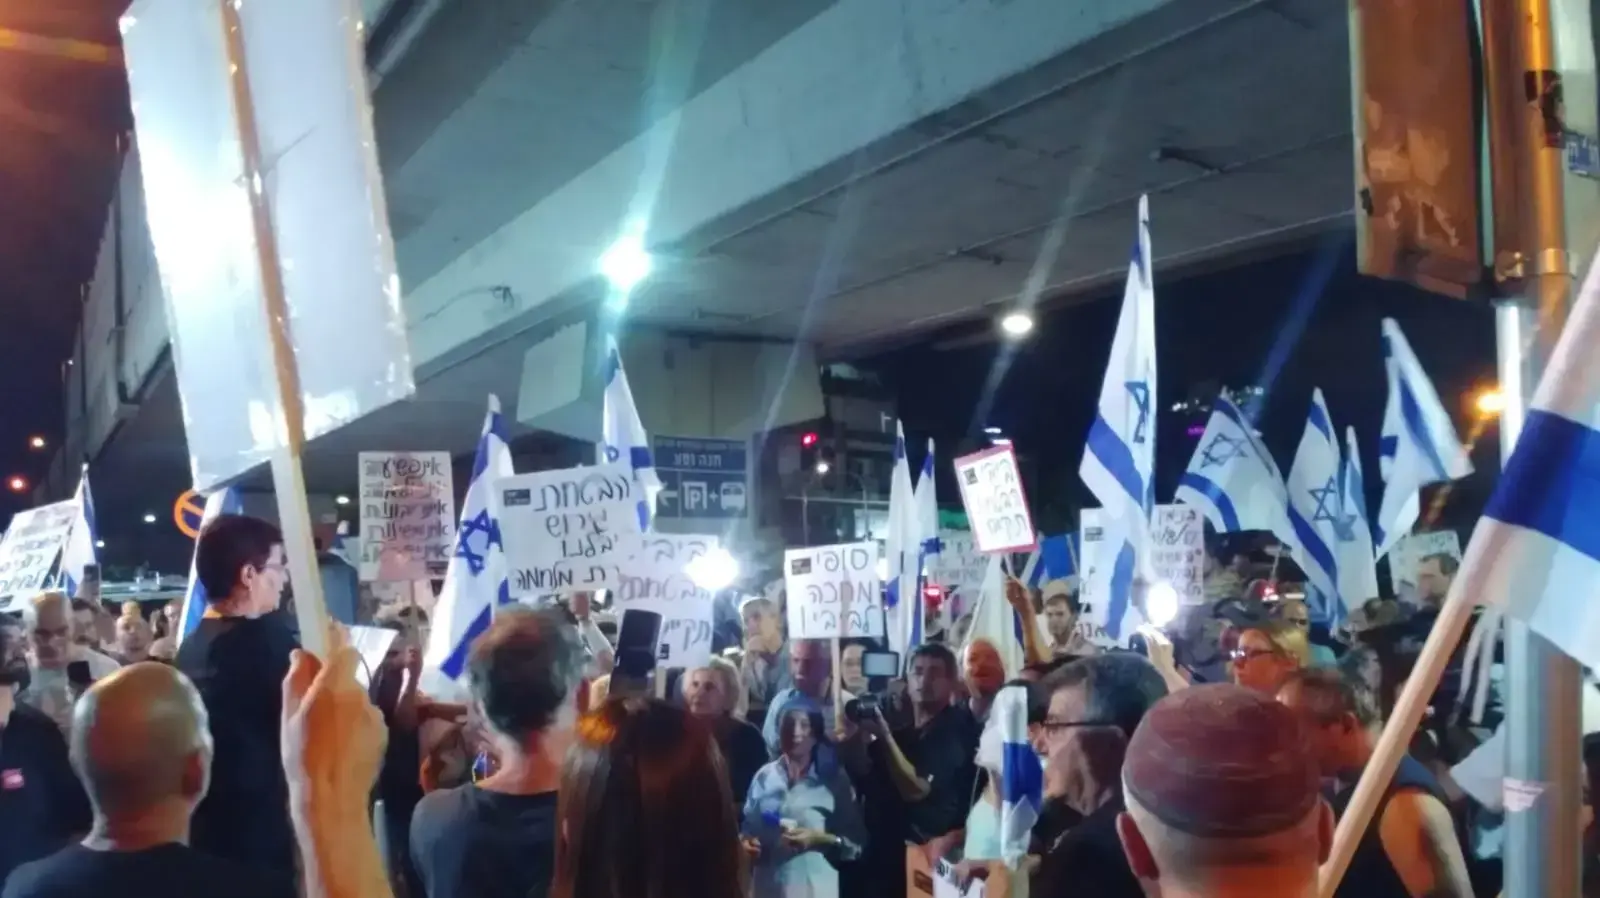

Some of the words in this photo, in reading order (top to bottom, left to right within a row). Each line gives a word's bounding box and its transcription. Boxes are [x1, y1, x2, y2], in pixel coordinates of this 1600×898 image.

[672, 452, 696, 467] וסע
[698, 453, 722, 468] חנה
[816, 547, 869, 572] סופי
[805, 580, 872, 605] מחכה
[662, 618, 712, 652] תקיי
